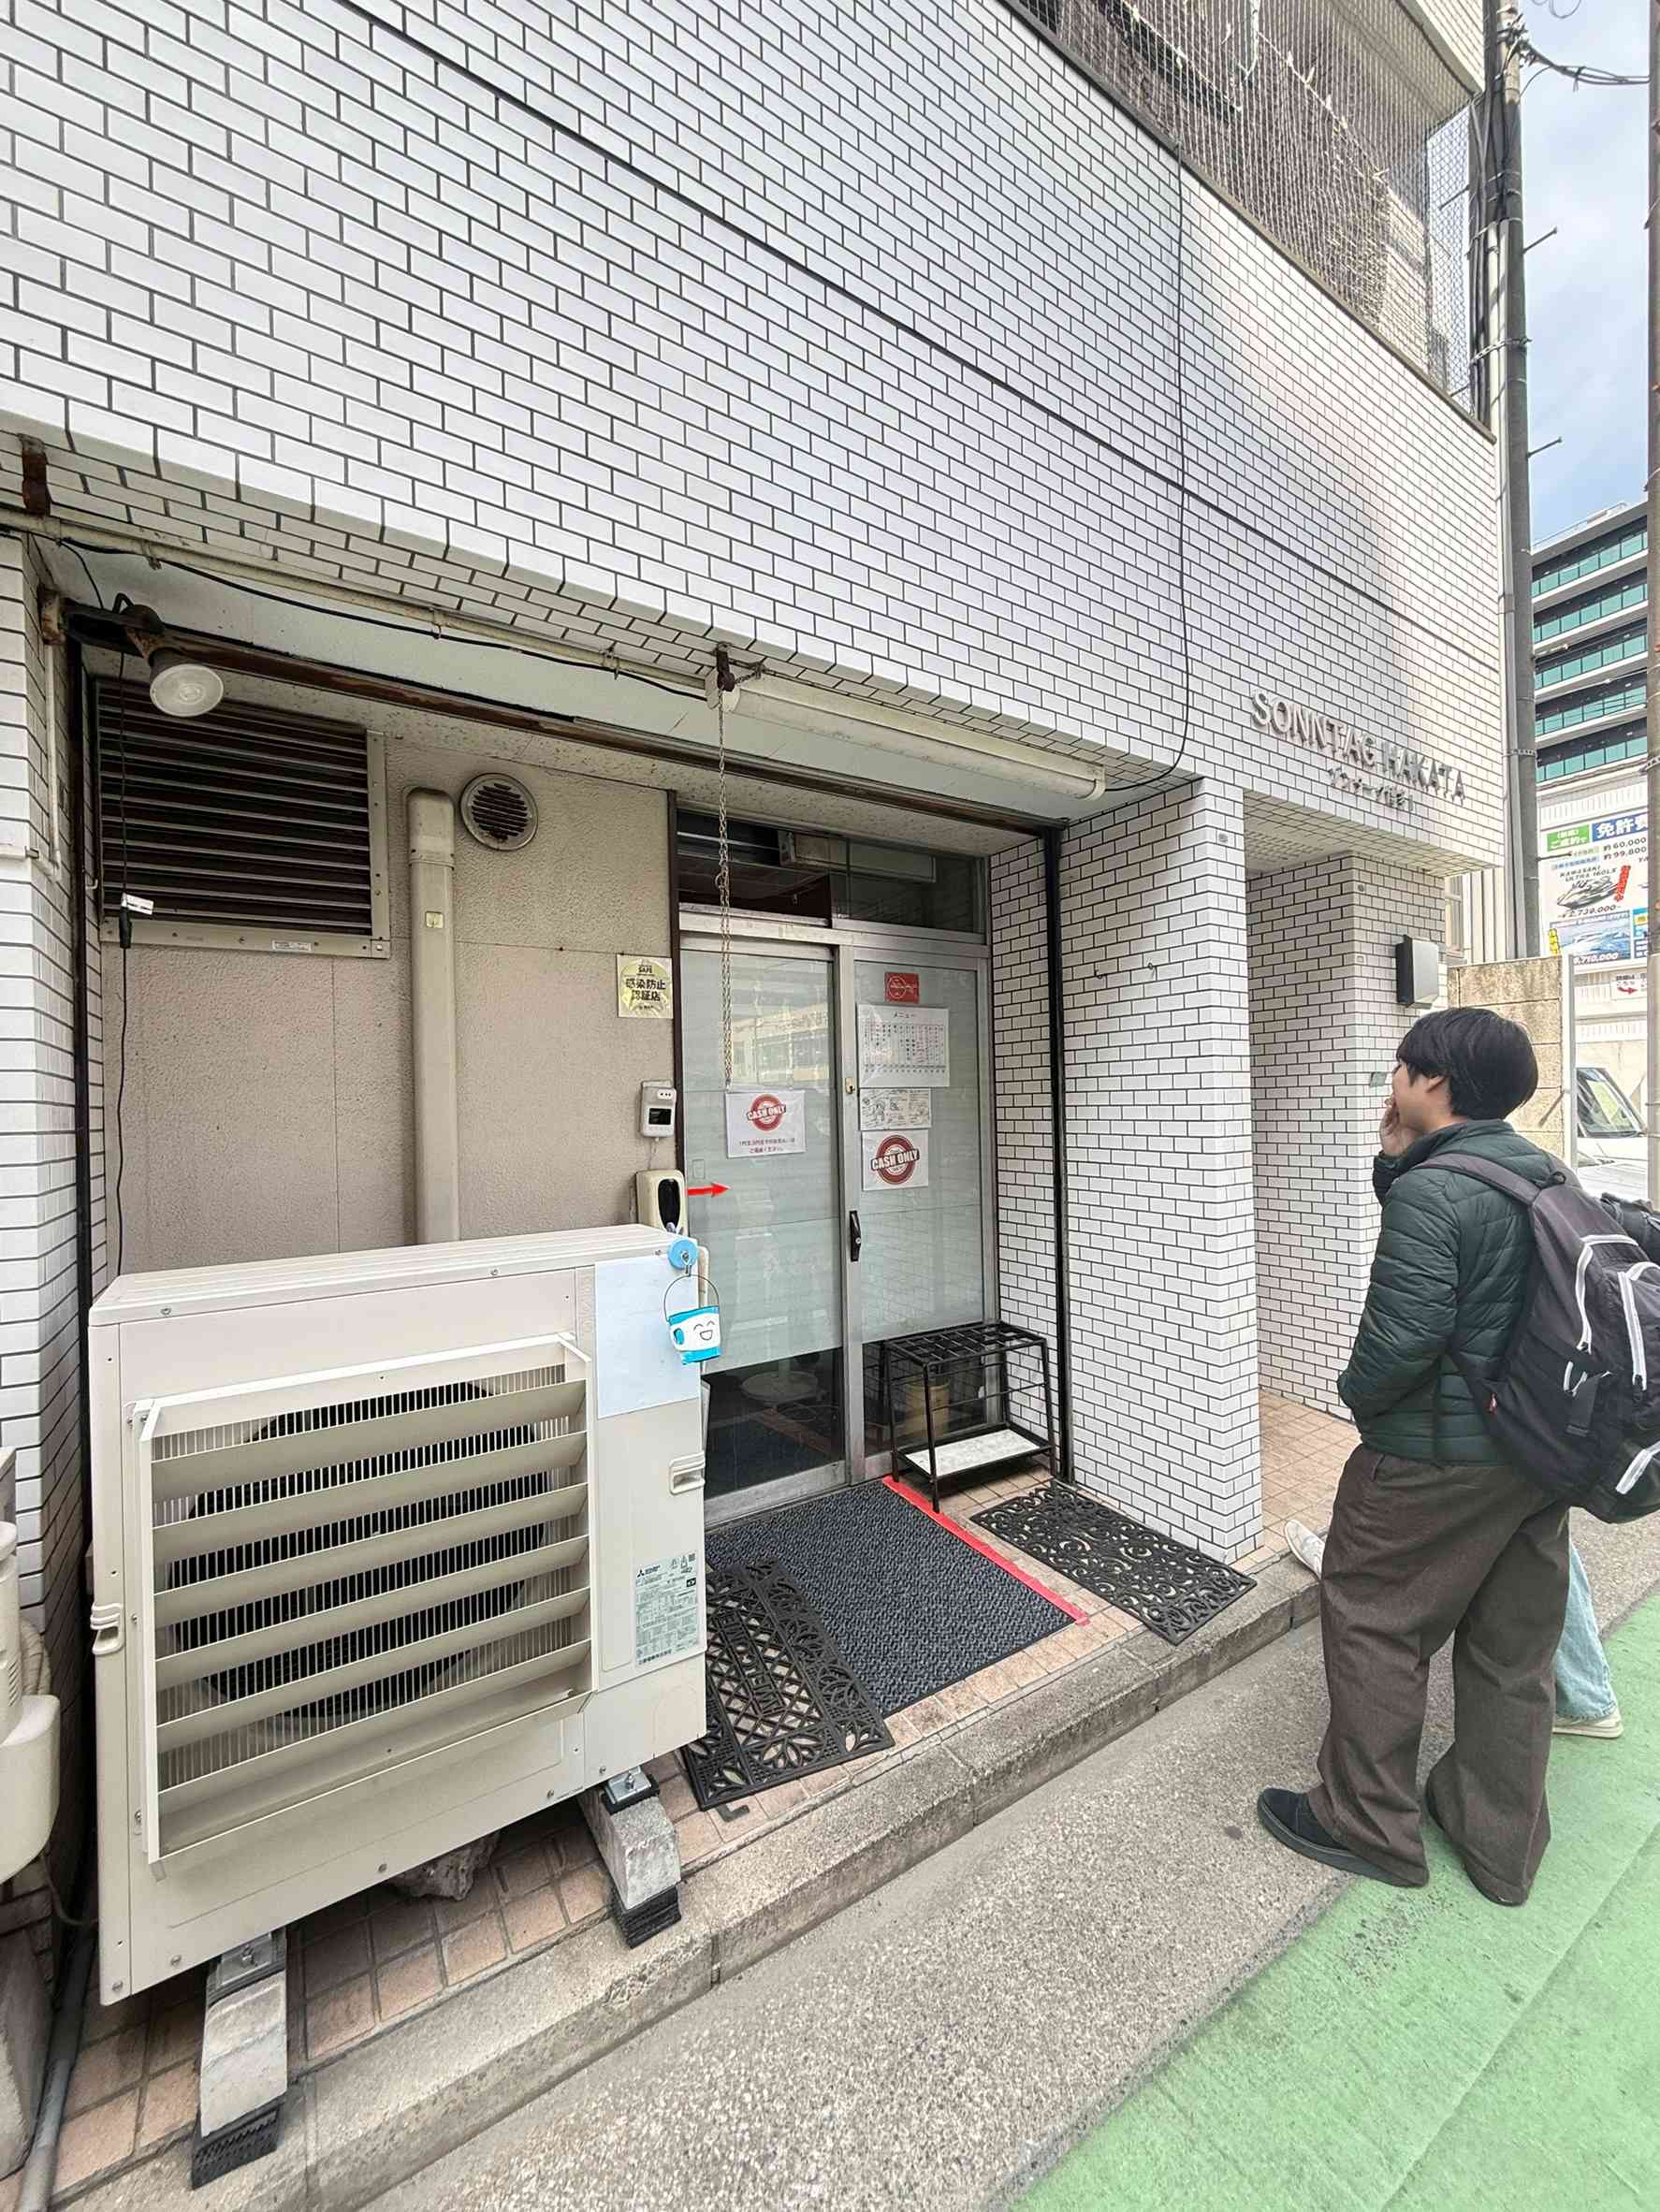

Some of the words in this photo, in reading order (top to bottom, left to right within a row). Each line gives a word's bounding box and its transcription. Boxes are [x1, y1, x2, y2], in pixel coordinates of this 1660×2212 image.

[1251, 691, 1376, 767] SONNTAG
[1380, 739, 1466, 807] HAKATA
[1560, 865, 1601, 878] KAWASAKI
[625, 978, 666, 990] 感染防止
[631, 990, 661, 1002] 認証店
[748, 1108, 767, 1121] CASH
[768, 1104, 786, 1116] ONLY
[871, 1154, 896, 1171] CASH
[896, 1149, 918, 1164] ONLY
